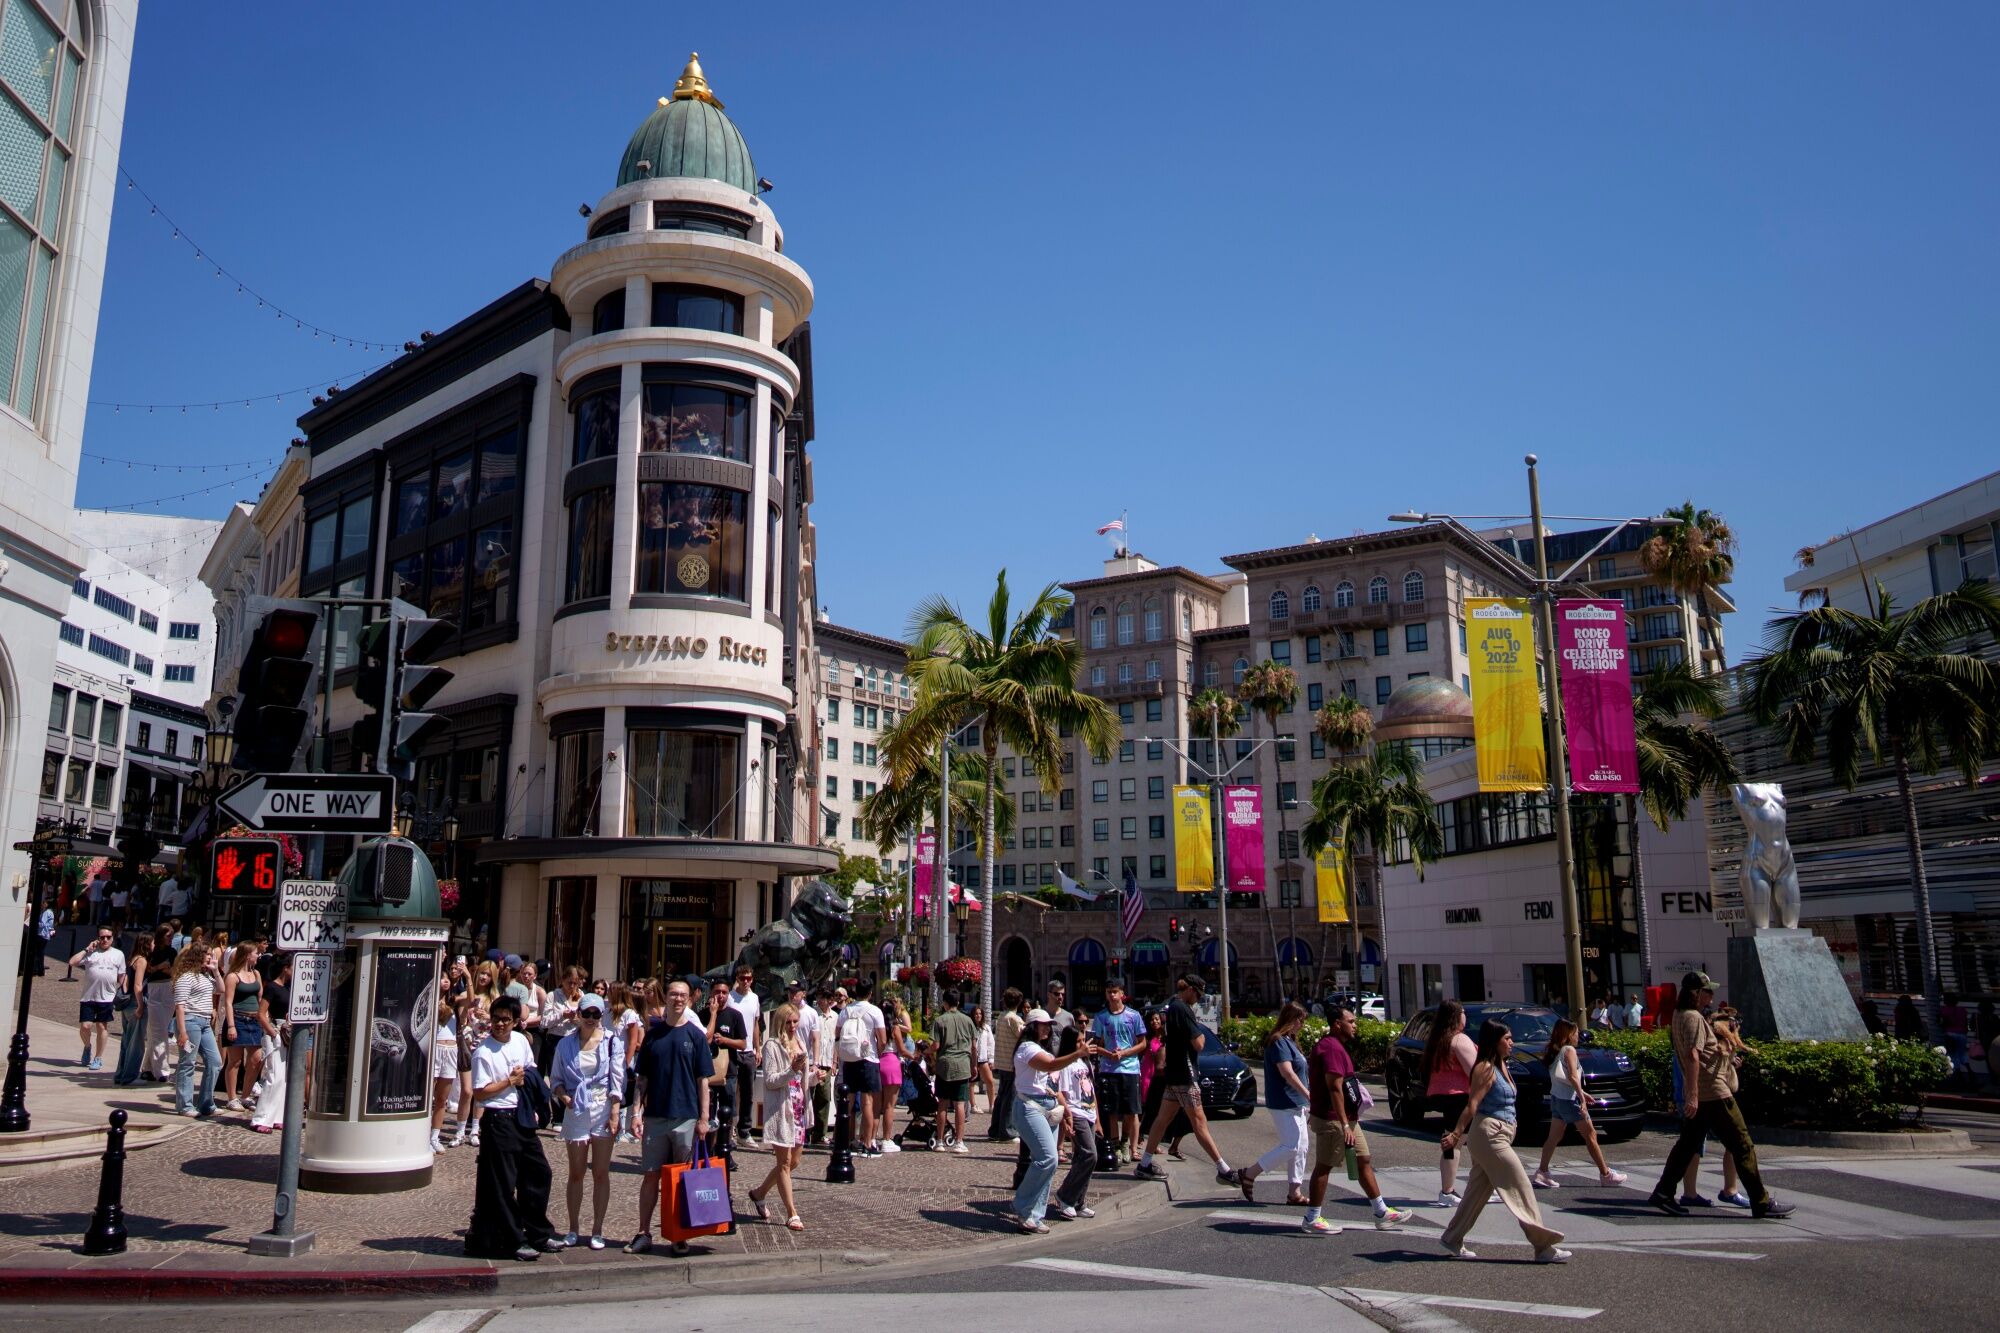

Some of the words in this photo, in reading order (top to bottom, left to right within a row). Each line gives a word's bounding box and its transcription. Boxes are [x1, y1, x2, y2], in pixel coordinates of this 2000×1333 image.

[1487, 628, 1512, 640] AUG
[1574, 628, 1610, 639] RODEO
[606, 632, 709, 653] STEFANO
[719, 636, 767, 664] RICCI
[1480, 640, 1489, 651] 4
[1507, 640, 1521, 652] 10
[1577, 639, 1610, 649] DRIVE
[1486, 652, 1518, 664] 2025
[1563, 649, 1625, 660] CELEBRATES
[1572, 660, 1618, 670] FASHION
[271, 793, 315, 814] ONE
[327, 794, 371, 815] WAY
[16, 842, 48, 850] DAYTON
[54, 842, 69, 850] WAY
[254, 853, 275, 889] 16
[286, 885, 345, 897] DIAGONAL
[653, 896, 688, 904] STEFANO
[689, 895, 709, 905] RICCI
[283, 900, 346, 913] CROSSING
[1524, 901, 1554, 921] FENDI
[1445, 907, 1481, 924] RIMOWA
[1716, 909, 1733, 921] LOUIS
[281, 920, 306, 942] OK
[380, 926, 399, 937] TWO
[401, 927, 427, 937] RODEO
[1583, 947, 1600, 958] FENDI
[299, 960, 327, 970] CROSS
[301, 971, 323, 981] ONLY
[305, 983, 317, 993] ON
[299, 995, 321, 1004] WALK
[293, 1006, 323, 1016] SIGNAL
